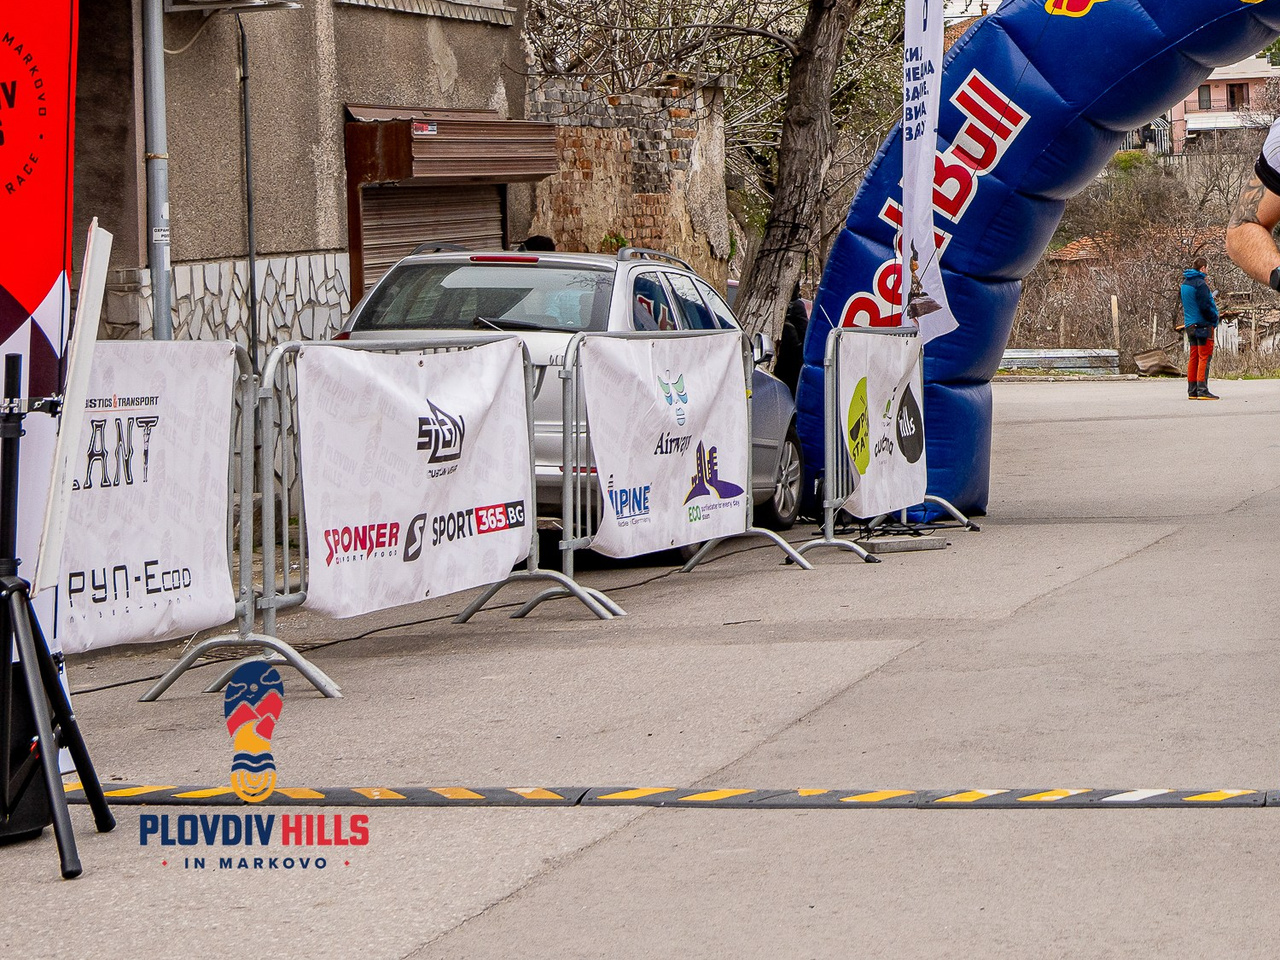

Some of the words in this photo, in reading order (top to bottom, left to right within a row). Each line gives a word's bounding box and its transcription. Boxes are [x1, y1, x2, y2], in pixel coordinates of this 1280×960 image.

[3, 32, 47, 117] MARKOVO
[5, 153, 39, 195] RACE
[932, 73, 1027, 221] Bull
[72, 415, 159, 491] ANT
[687, 504, 701, 523] ECO
[324, 522, 400, 567] SPONSER
